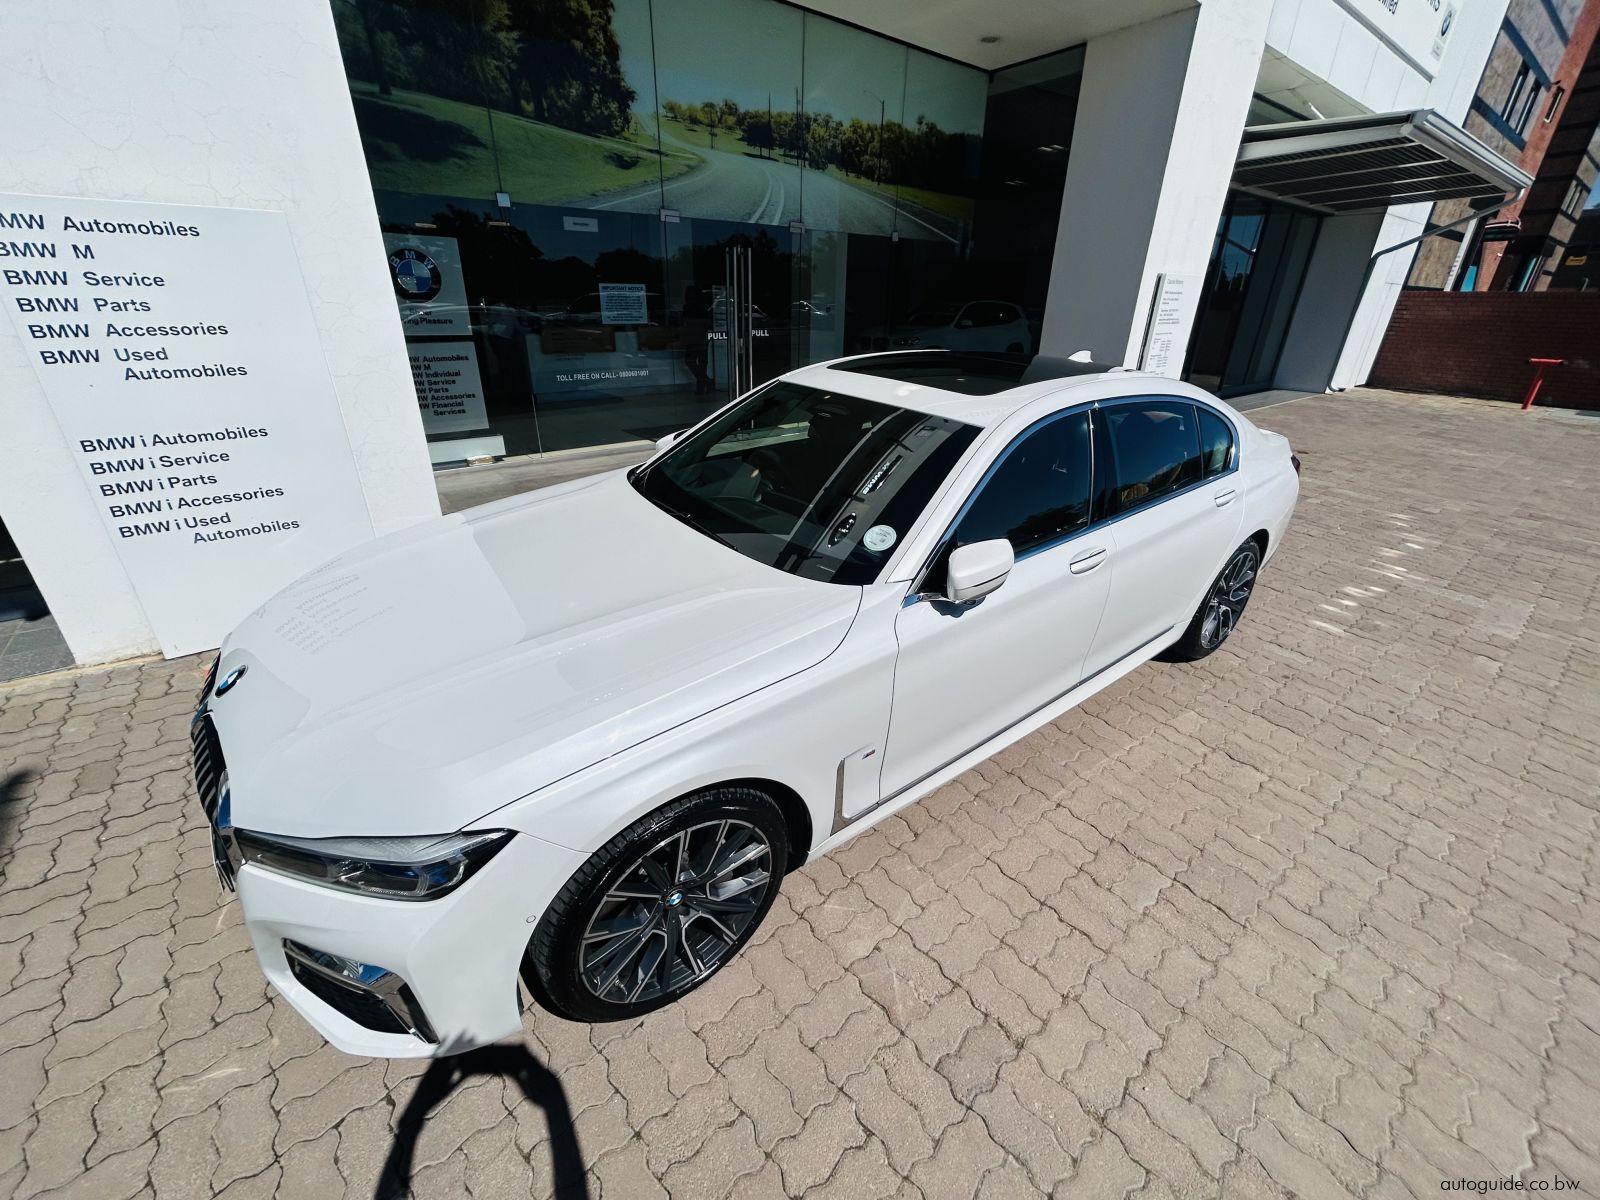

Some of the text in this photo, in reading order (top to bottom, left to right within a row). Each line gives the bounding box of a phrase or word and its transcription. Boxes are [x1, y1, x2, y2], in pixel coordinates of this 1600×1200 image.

[0, 213, 200, 237] MW Automobiles
[0, 242, 95, 260] BMW M
[3, 270, 165, 287] BMW Service
[16, 298, 151, 312] BMW Parts
[420, 317, 453, 325] Pleasure
[28, 322, 229, 339] BMW Accessories
[707, 332, 728, 340] PULL
[40, 347, 169, 365] BMW Used
[423, 354, 469, 362] Automobiles
[124, 364, 248, 381] Automobiles
[425, 370, 461, 378] Individual
[573, 373, 590, 381] FREE
[431, 392, 476, 401] Accessories
[431, 400, 464, 409] Financial
[433, 408, 466, 416] Services
[80, 426, 268, 453] BMW i Automobiles
[90, 452, 230, 475] BMW i Service
[100, 473, 218, 497] BMW i Parts
[109, 485, 285, 518] BMW i Accessories
[119, 512, 231, 539] BMW i Used
[193, 519, 300, 544] Automobiles
